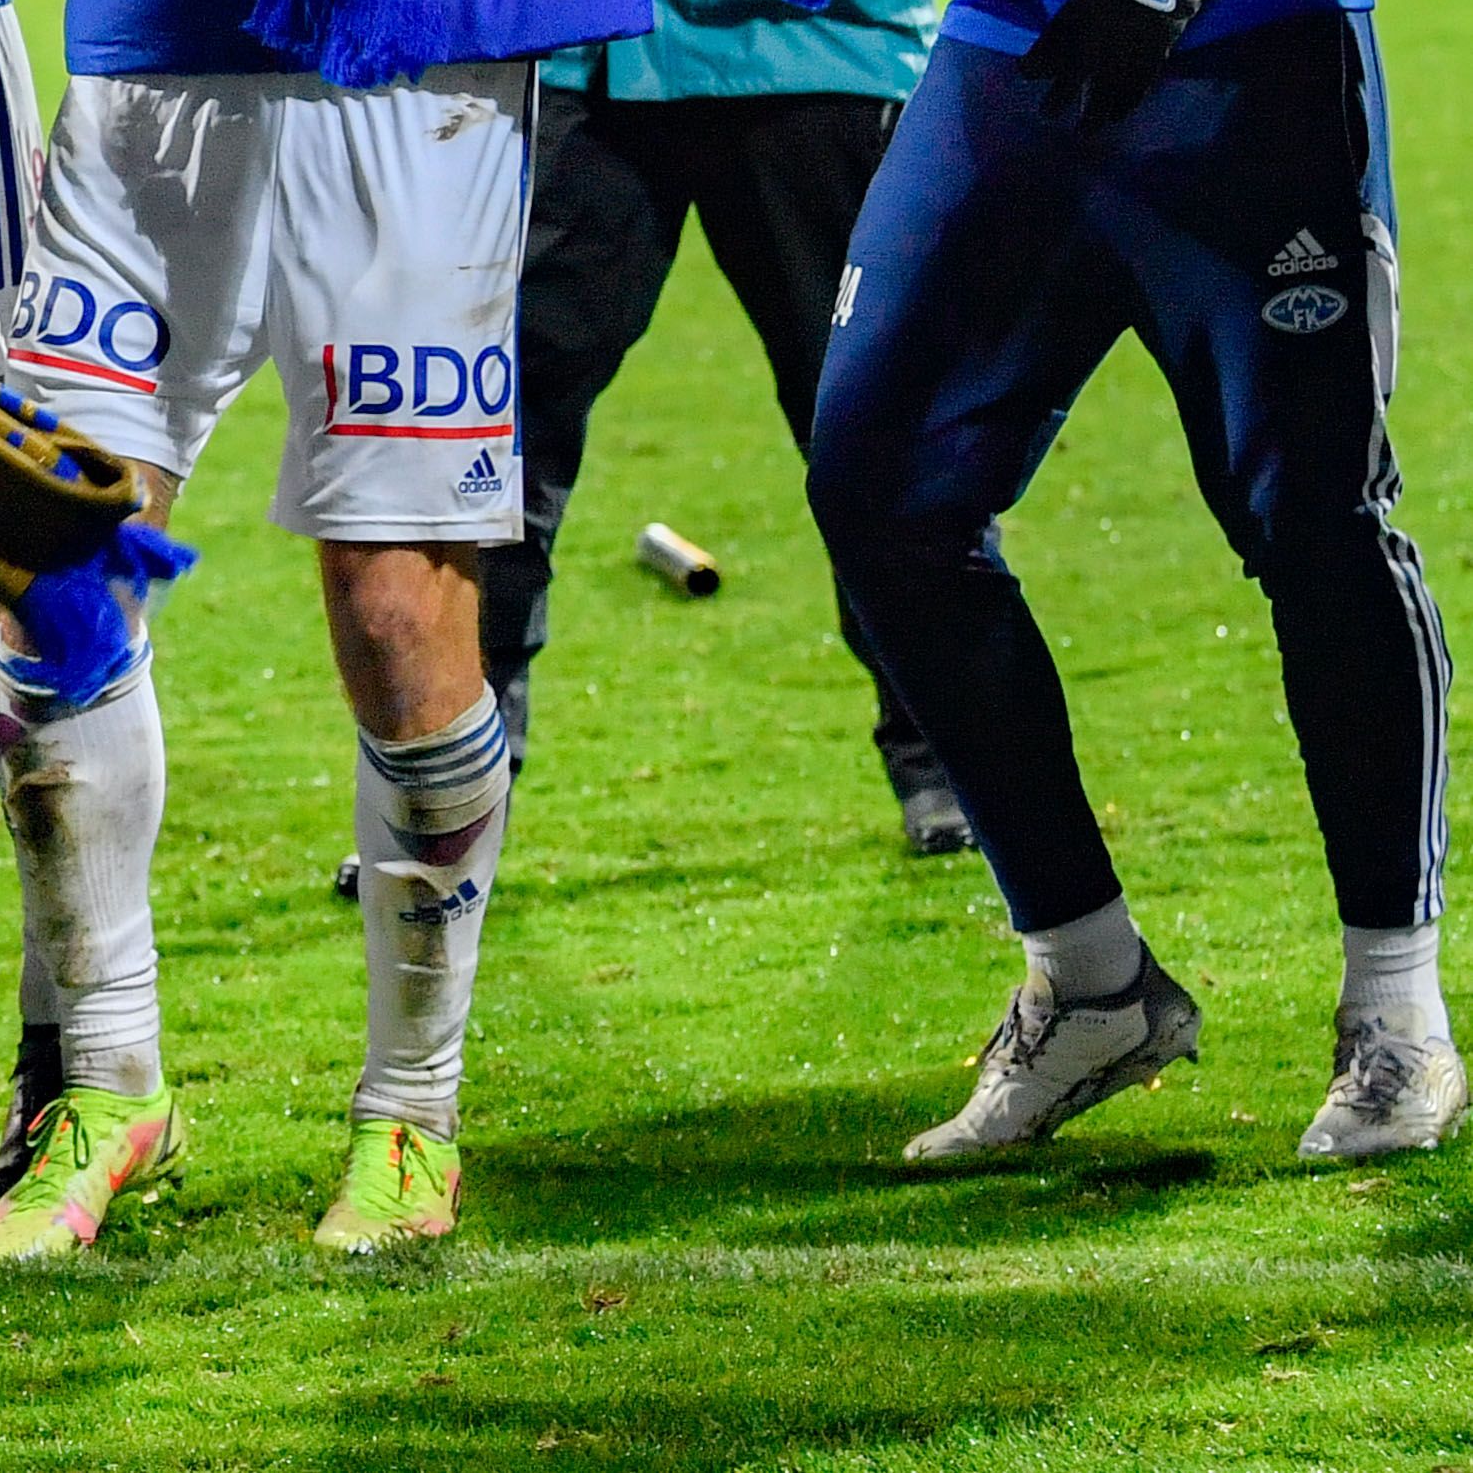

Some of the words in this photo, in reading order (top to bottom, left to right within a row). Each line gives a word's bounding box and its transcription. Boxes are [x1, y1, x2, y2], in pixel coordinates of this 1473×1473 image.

[1267, 255, 1339, 277] adidas
[11, 269, 171, 373] BDO
[349, 343, 512, 418] BDO
[458, 478, 503, 495] adidas
